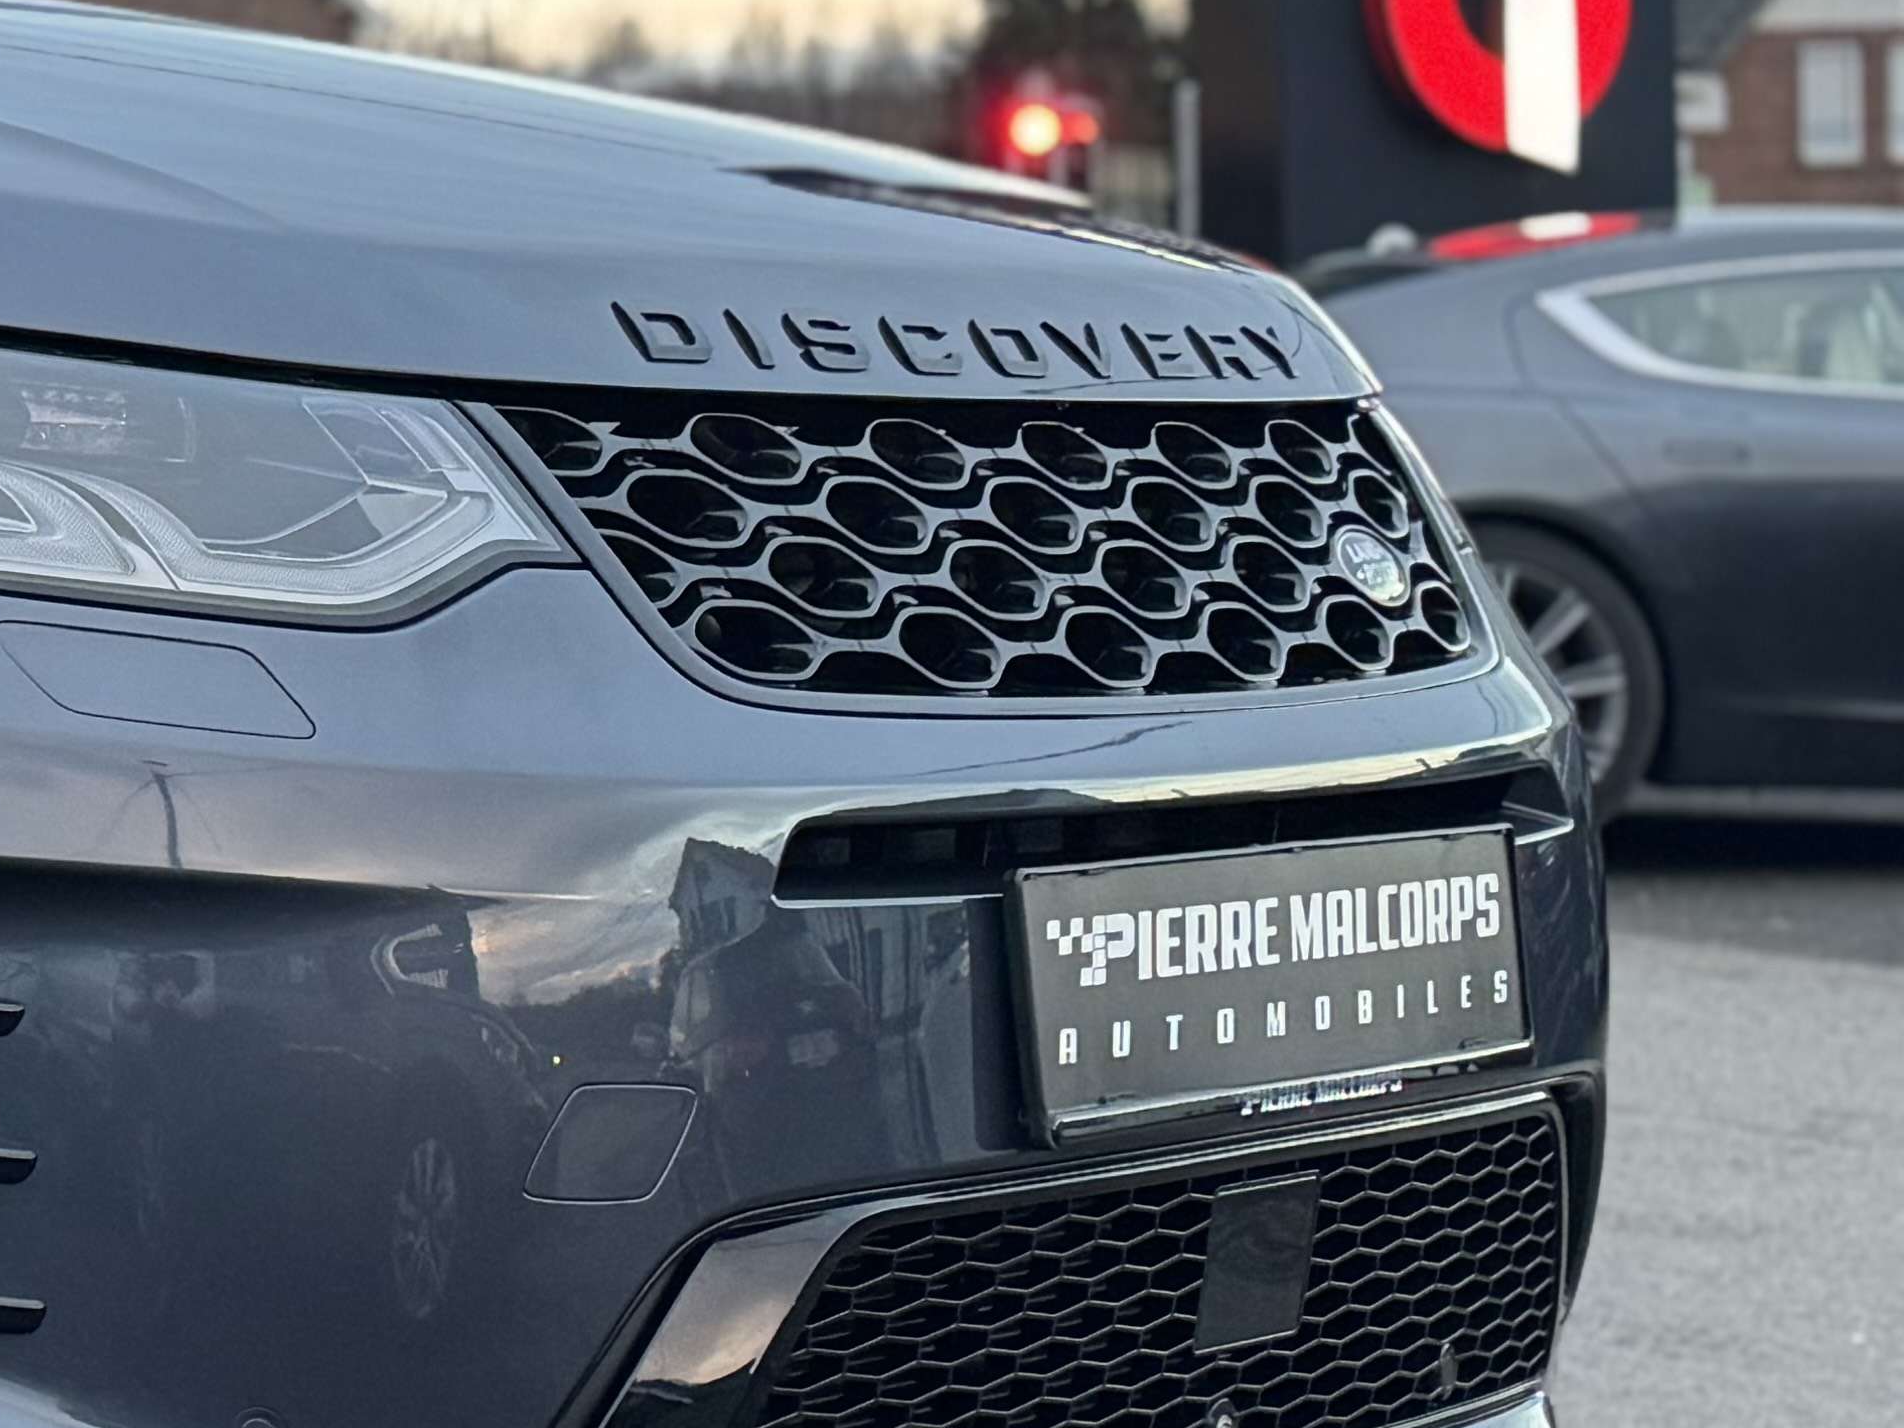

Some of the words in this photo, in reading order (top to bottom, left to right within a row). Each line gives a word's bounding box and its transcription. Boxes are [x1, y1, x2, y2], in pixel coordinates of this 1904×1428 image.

[611, 301, 1298, 380] DISCOVERY
[1078, 897, 1281, 987] PIERRE
[1289, 873, 1500, 962] MALCORPS
[1058, 970, 1508, 1065] AUTOMOBILES
